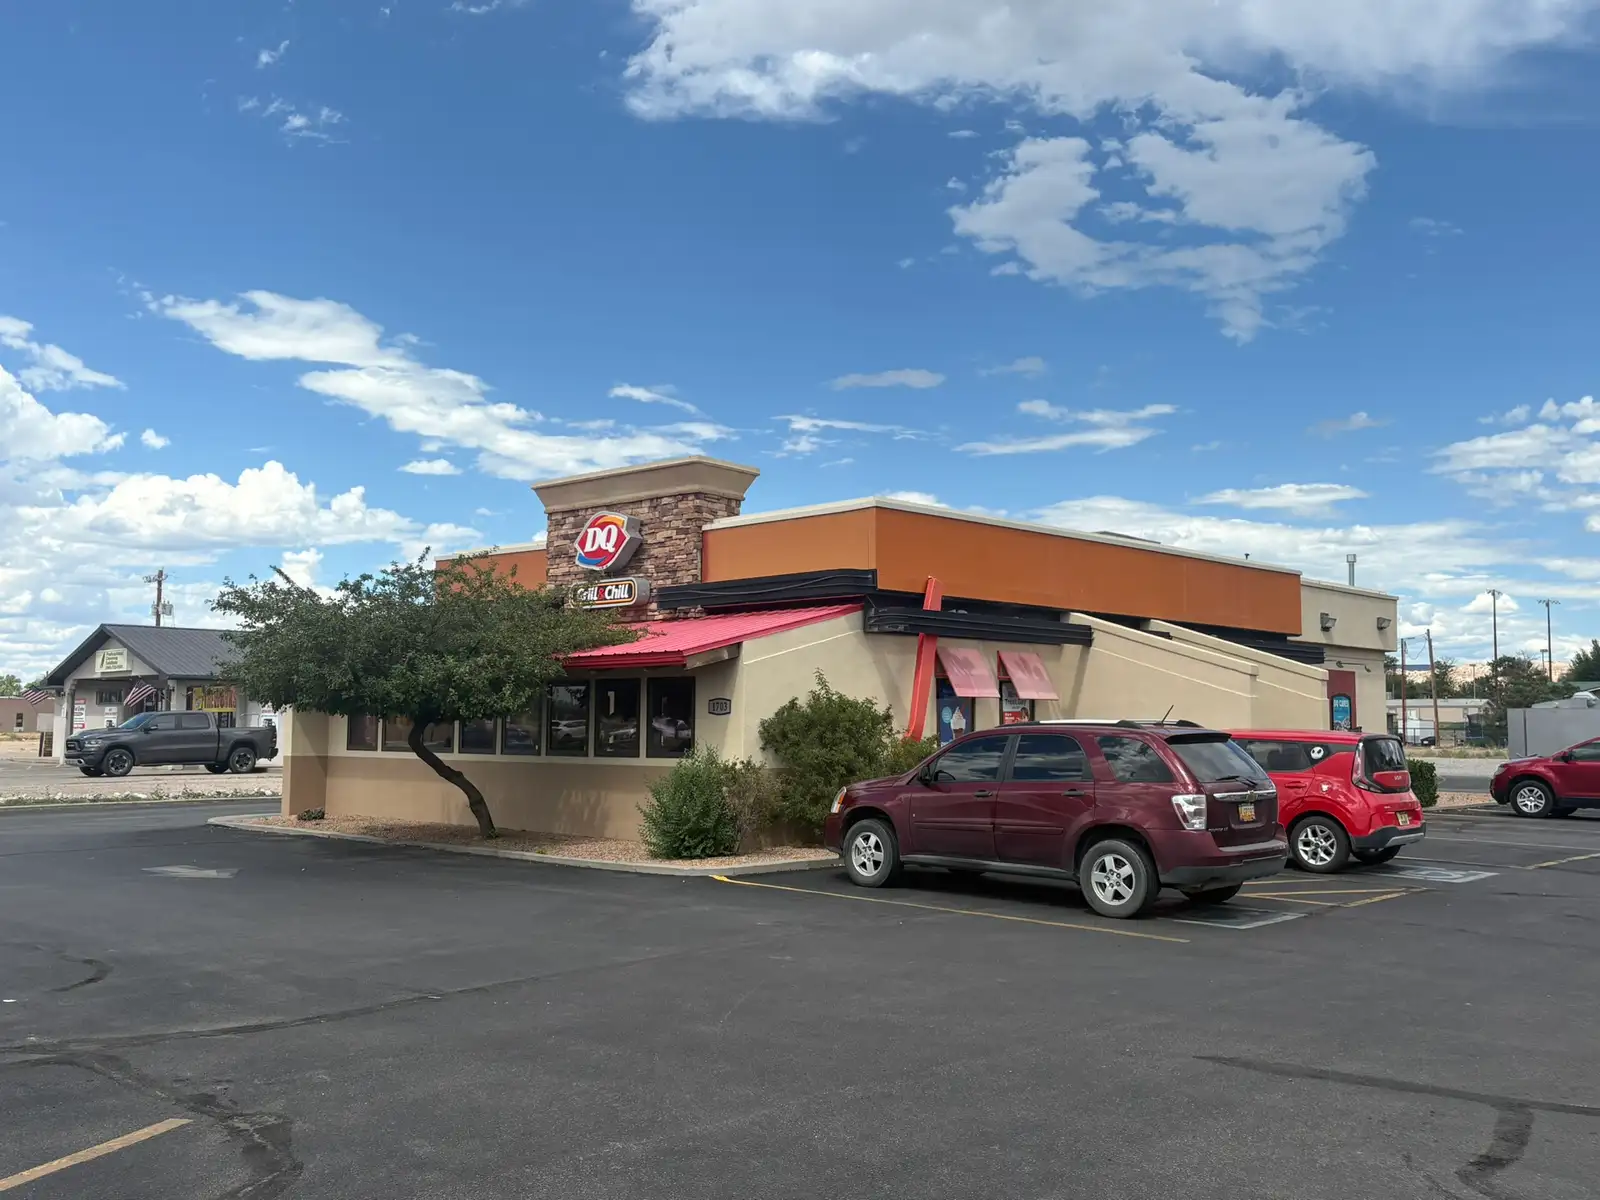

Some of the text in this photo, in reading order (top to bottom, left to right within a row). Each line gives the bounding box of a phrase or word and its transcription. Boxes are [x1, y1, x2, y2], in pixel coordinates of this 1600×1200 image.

[584, 525, 618, 553] DQ
[605, 584, 629, 599] Chill
[712, 701, 728, 712] 1703
